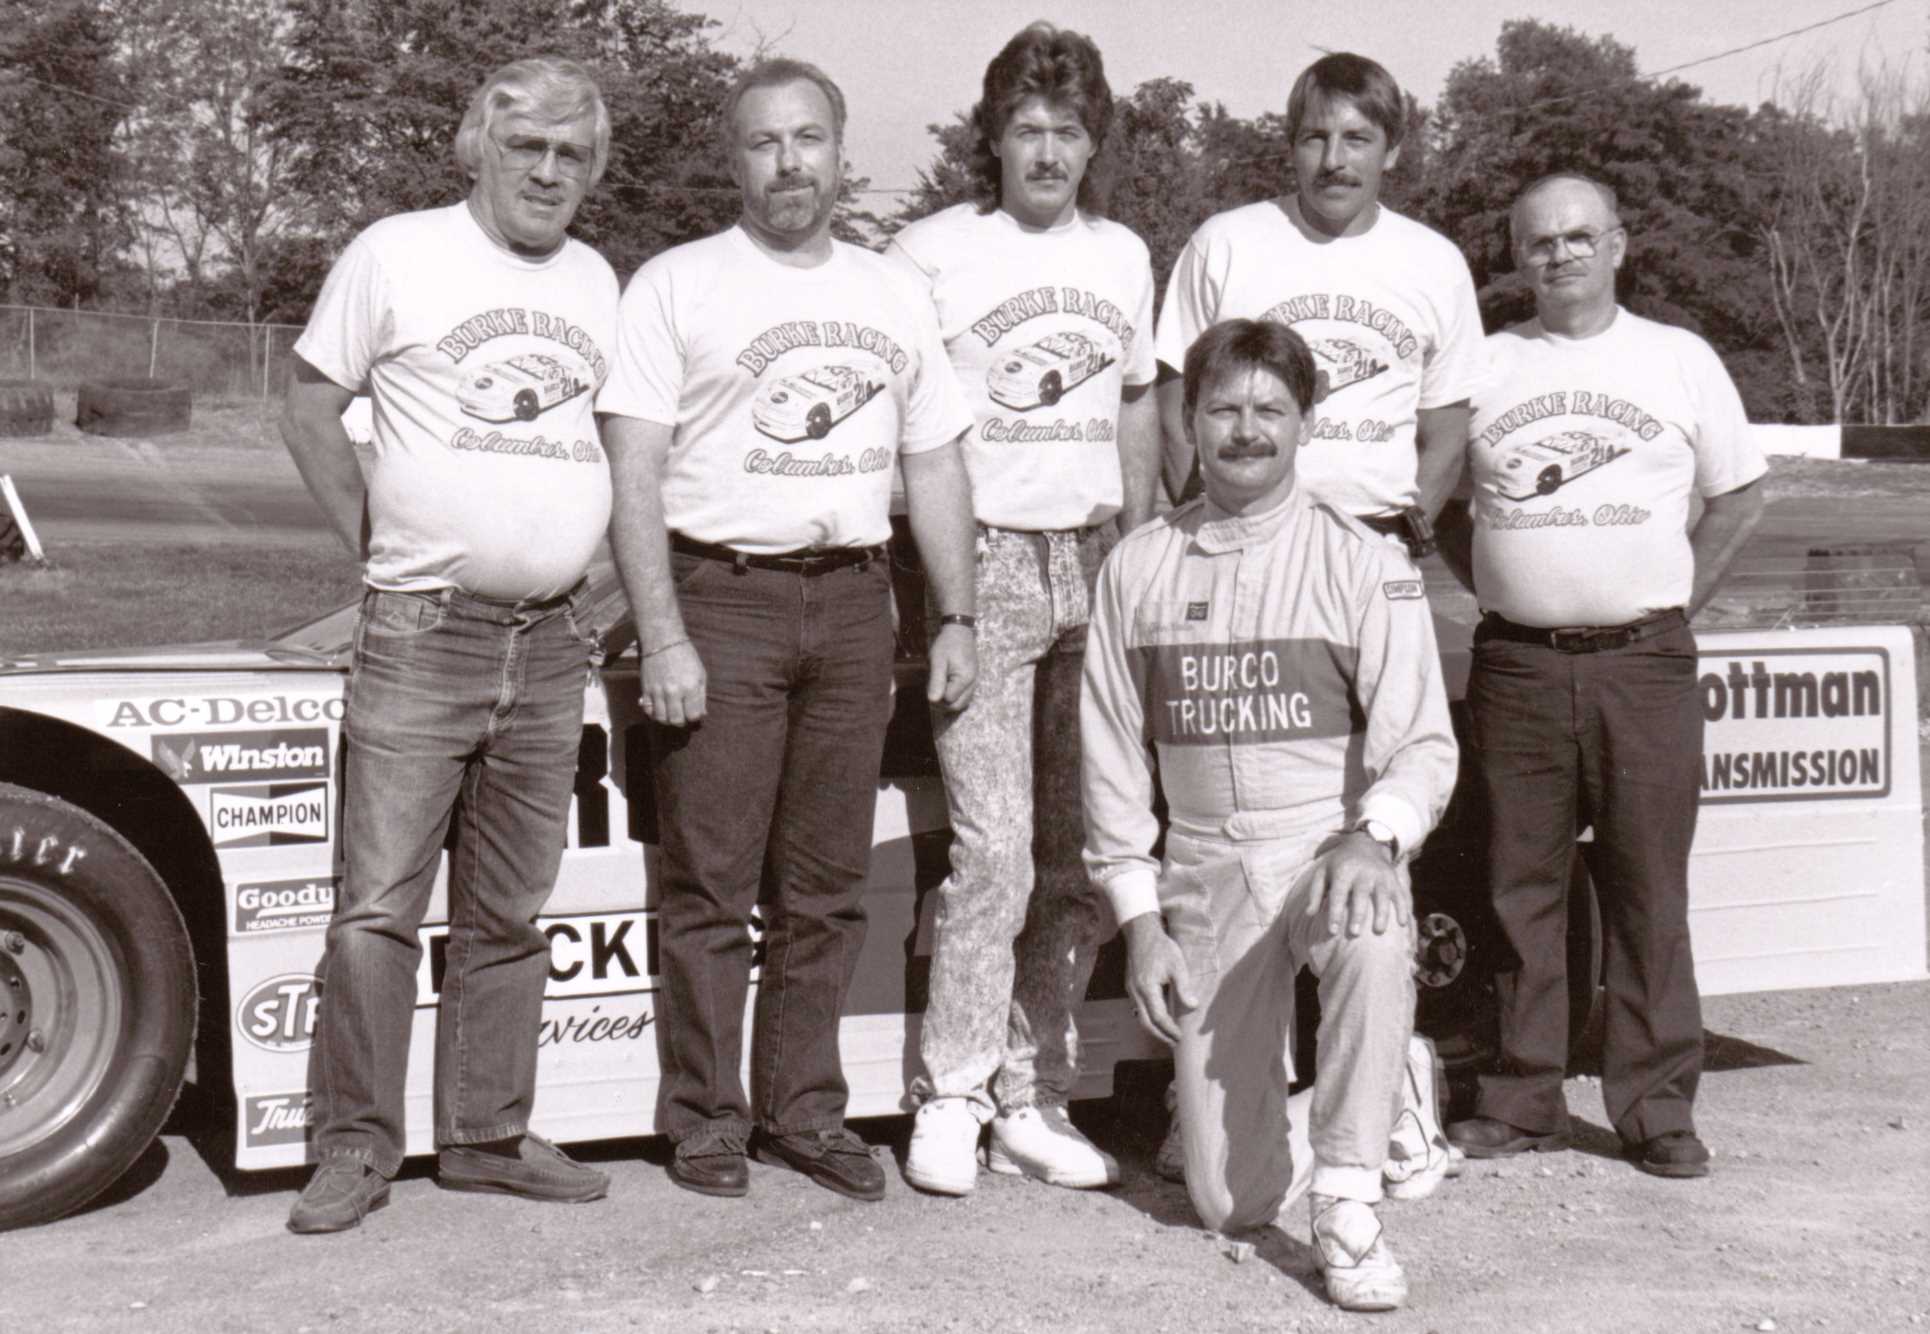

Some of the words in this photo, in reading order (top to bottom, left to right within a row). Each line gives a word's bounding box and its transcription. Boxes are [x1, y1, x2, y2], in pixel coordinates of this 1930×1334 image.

[436, 308, 530, 365] BURKE
[971, 286, 1058, 348] BURKE
[1334, 294, 1418, 360] RACING
[736, 321, 822, 378] BURKE
[822, 321, 909, 375] RACING
[1480, 392, 1566, 448] BURKE
[1571, 390, 1665, 442] RACING
[1181, 651, 1280, 692] BURCO
[1698, 661, 1881, 722] ottman
[106, 696, 346, 727] AC-Delco
[1166, 692, 1313, 736] TRUCKING
[200, 742, 325, 772] Winston
[1699, 748, 1880, 791] NSMISSION
[216, 802, 322, 828] CHAMPION
[538, 1005, 657, 1048] vices
